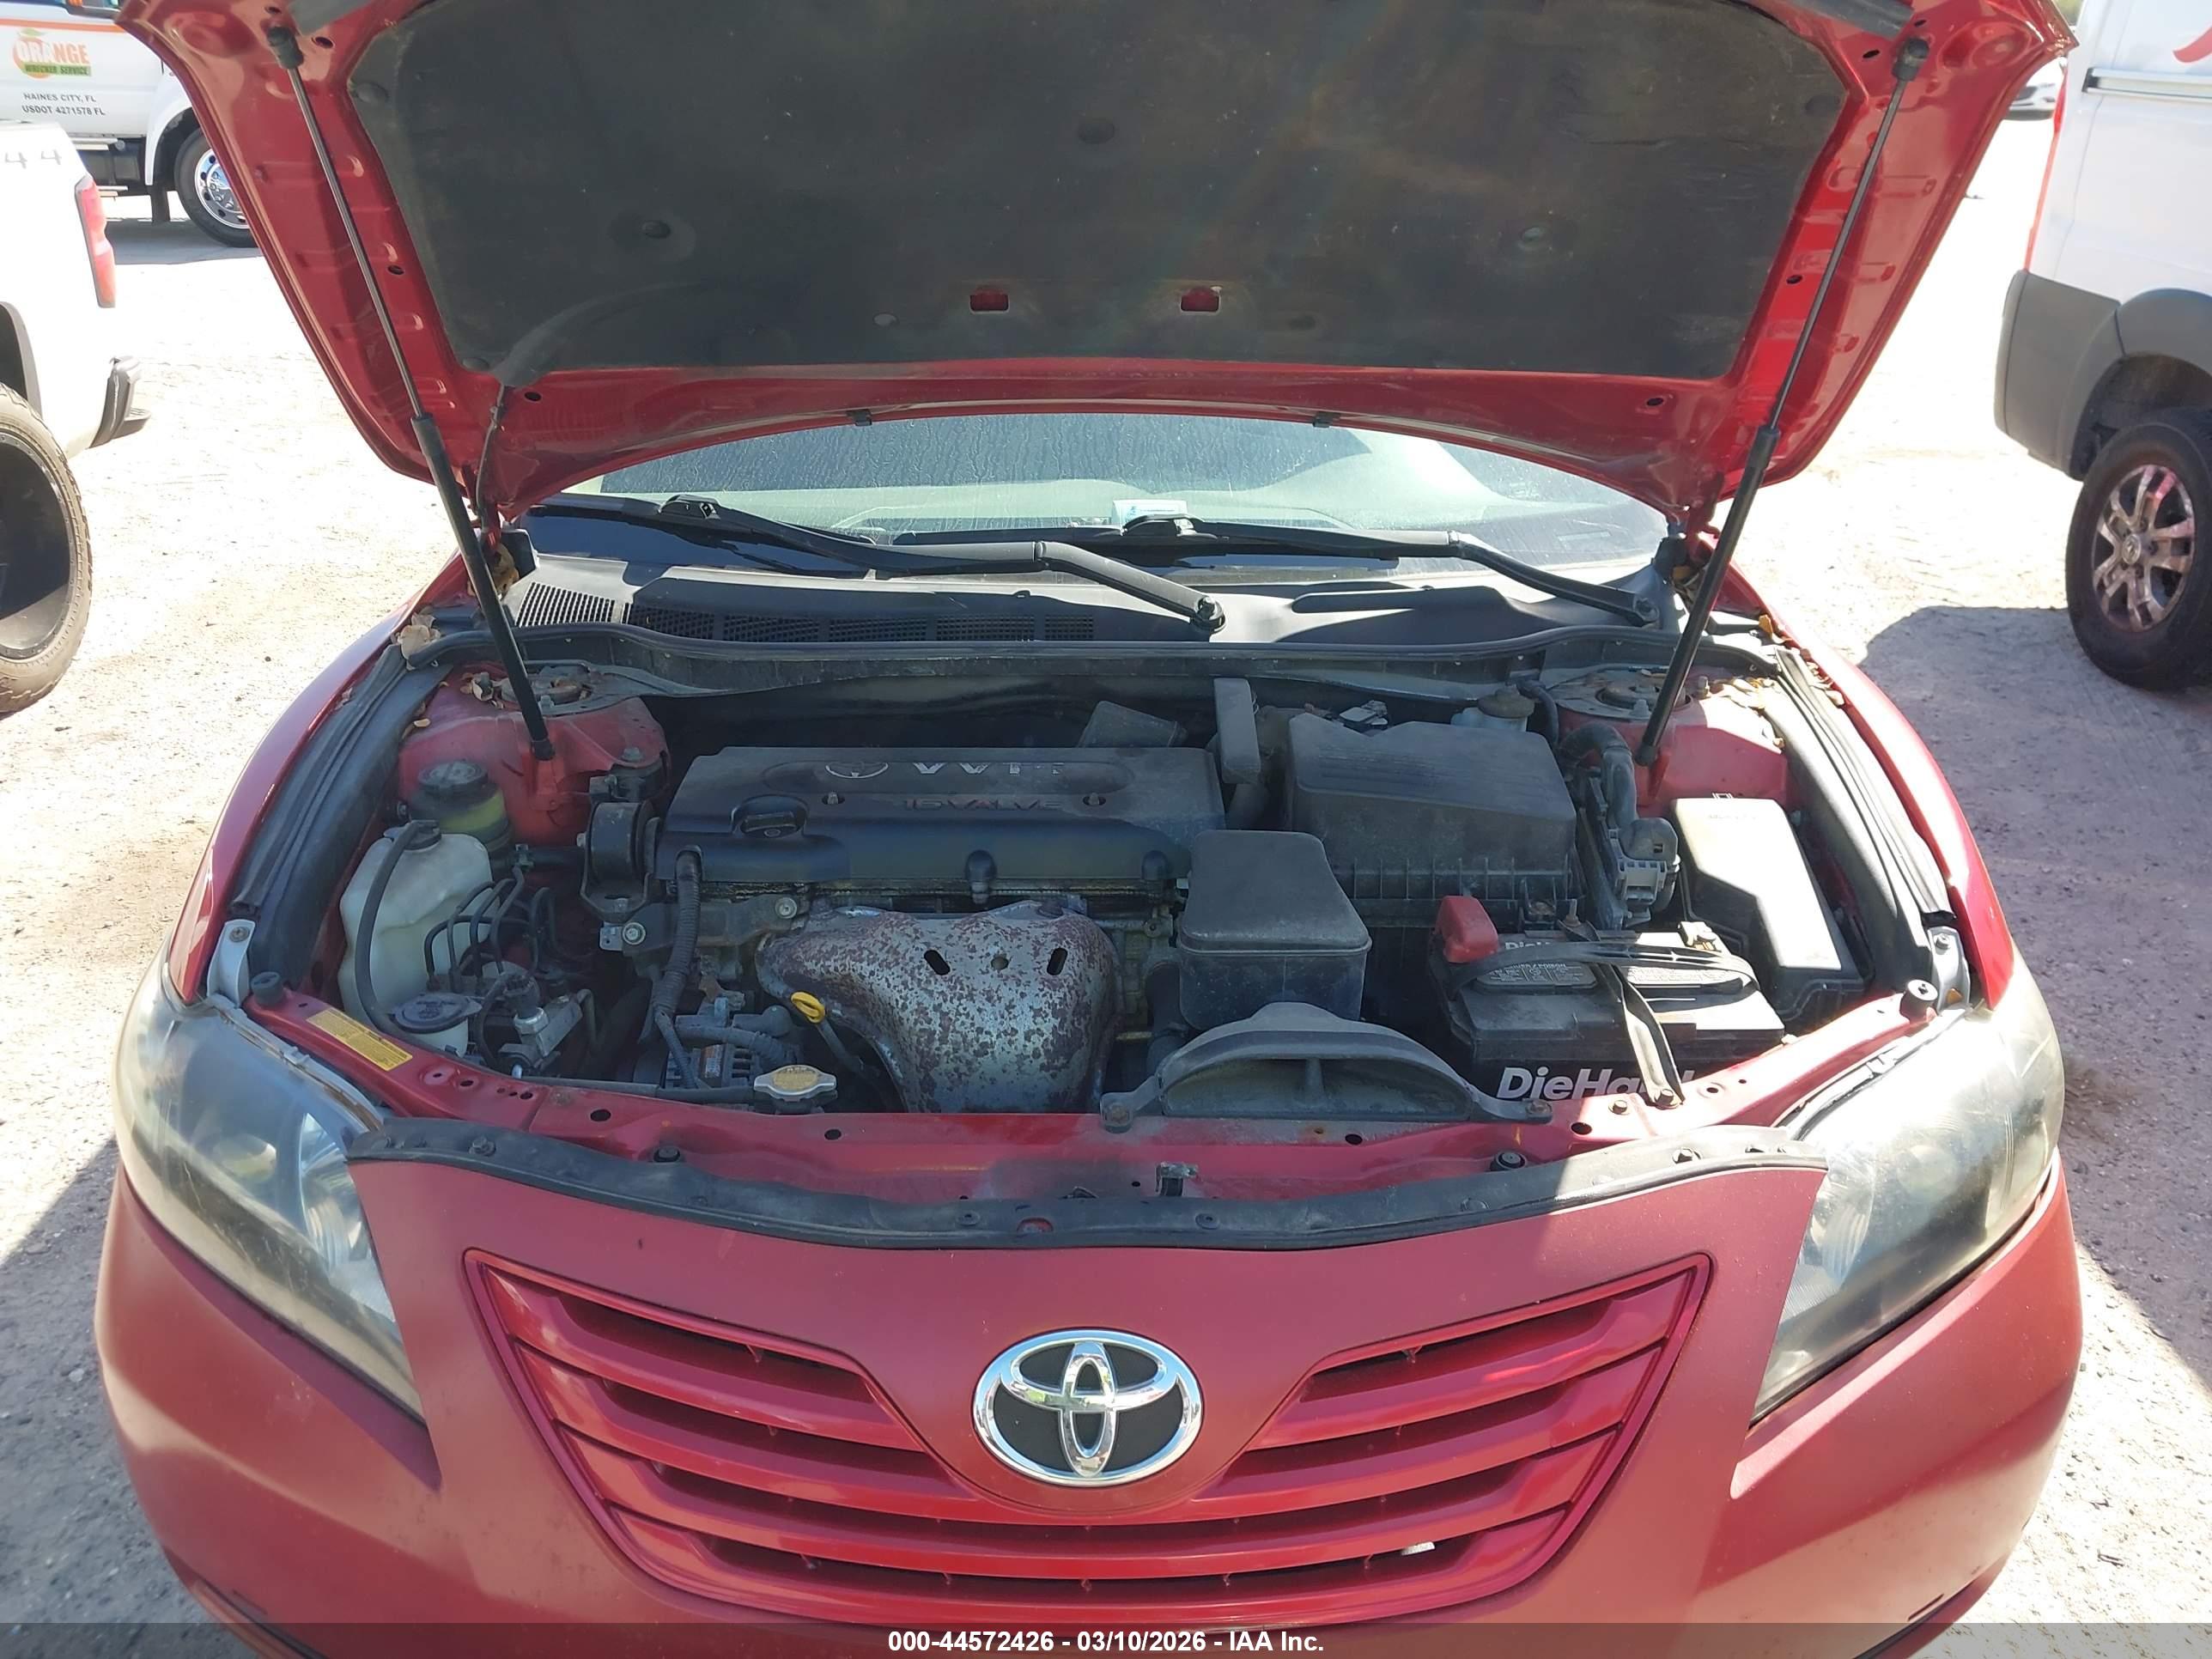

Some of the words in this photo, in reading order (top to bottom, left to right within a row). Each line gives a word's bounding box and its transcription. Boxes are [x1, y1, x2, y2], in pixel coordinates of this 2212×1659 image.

[16, 41, 89, 64] ORANGE
[23, 93, 58, 101] HAINES
[21, 105, 53, 113] USDOT
